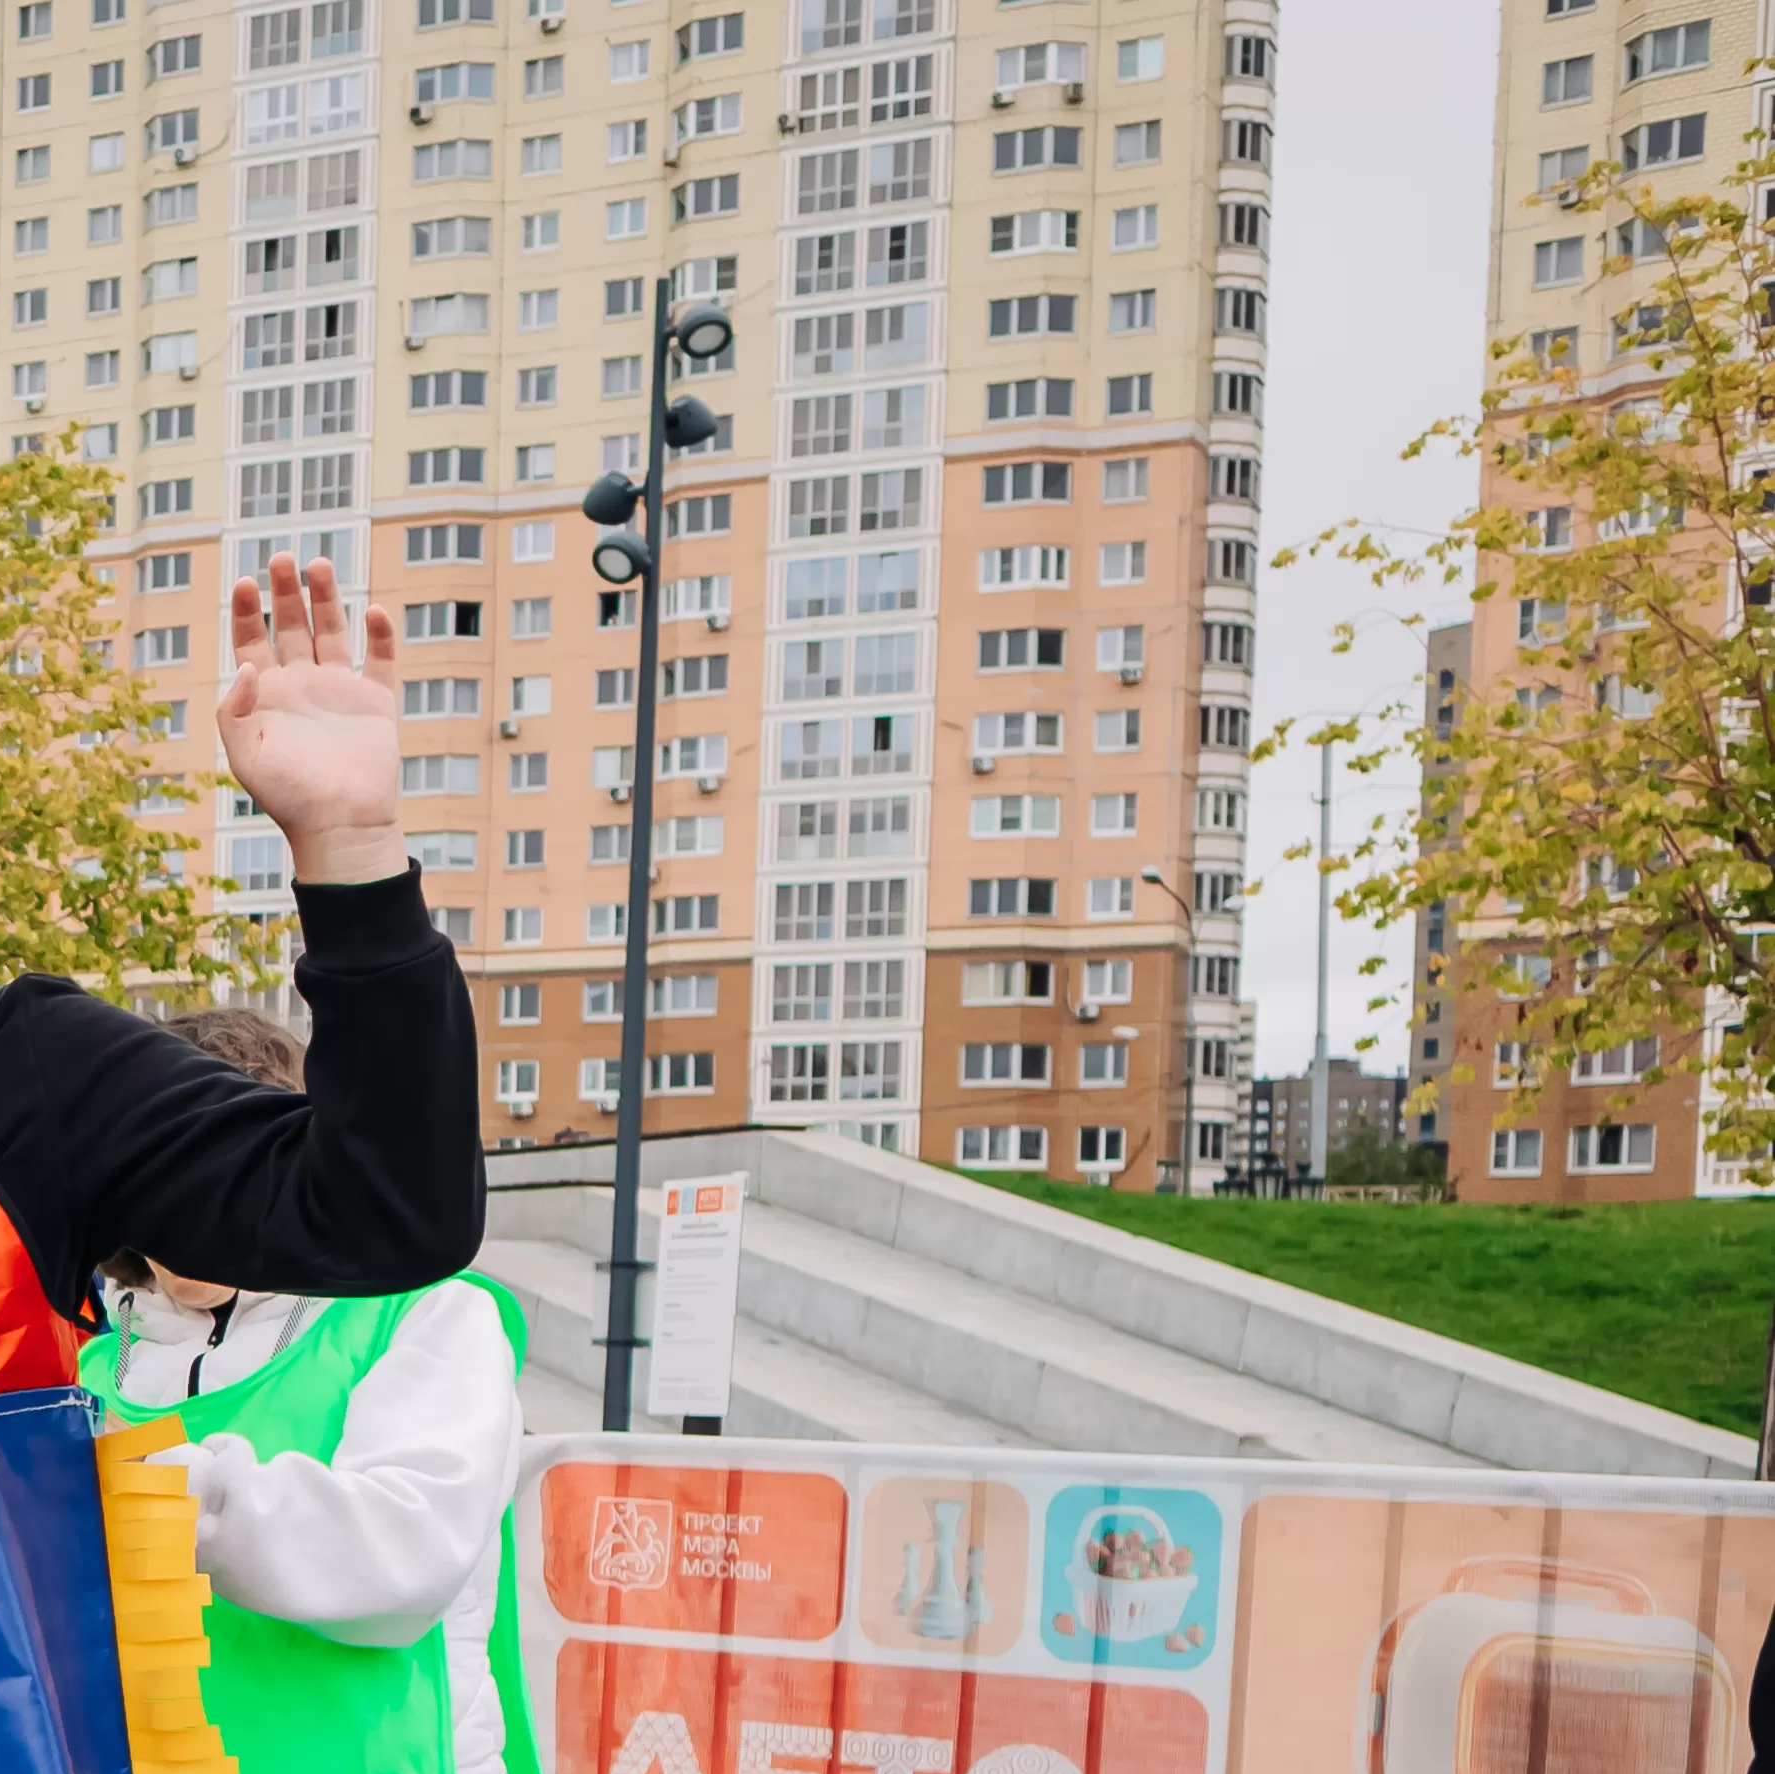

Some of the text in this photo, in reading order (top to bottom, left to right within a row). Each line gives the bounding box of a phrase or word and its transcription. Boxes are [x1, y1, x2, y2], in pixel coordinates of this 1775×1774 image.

[684, 1511, 764, 1535] ПРОЕКТ
[682, 1535, 740, 1556] МЭРА
[681, 1556, 772, 1582] МОСКВЫ
